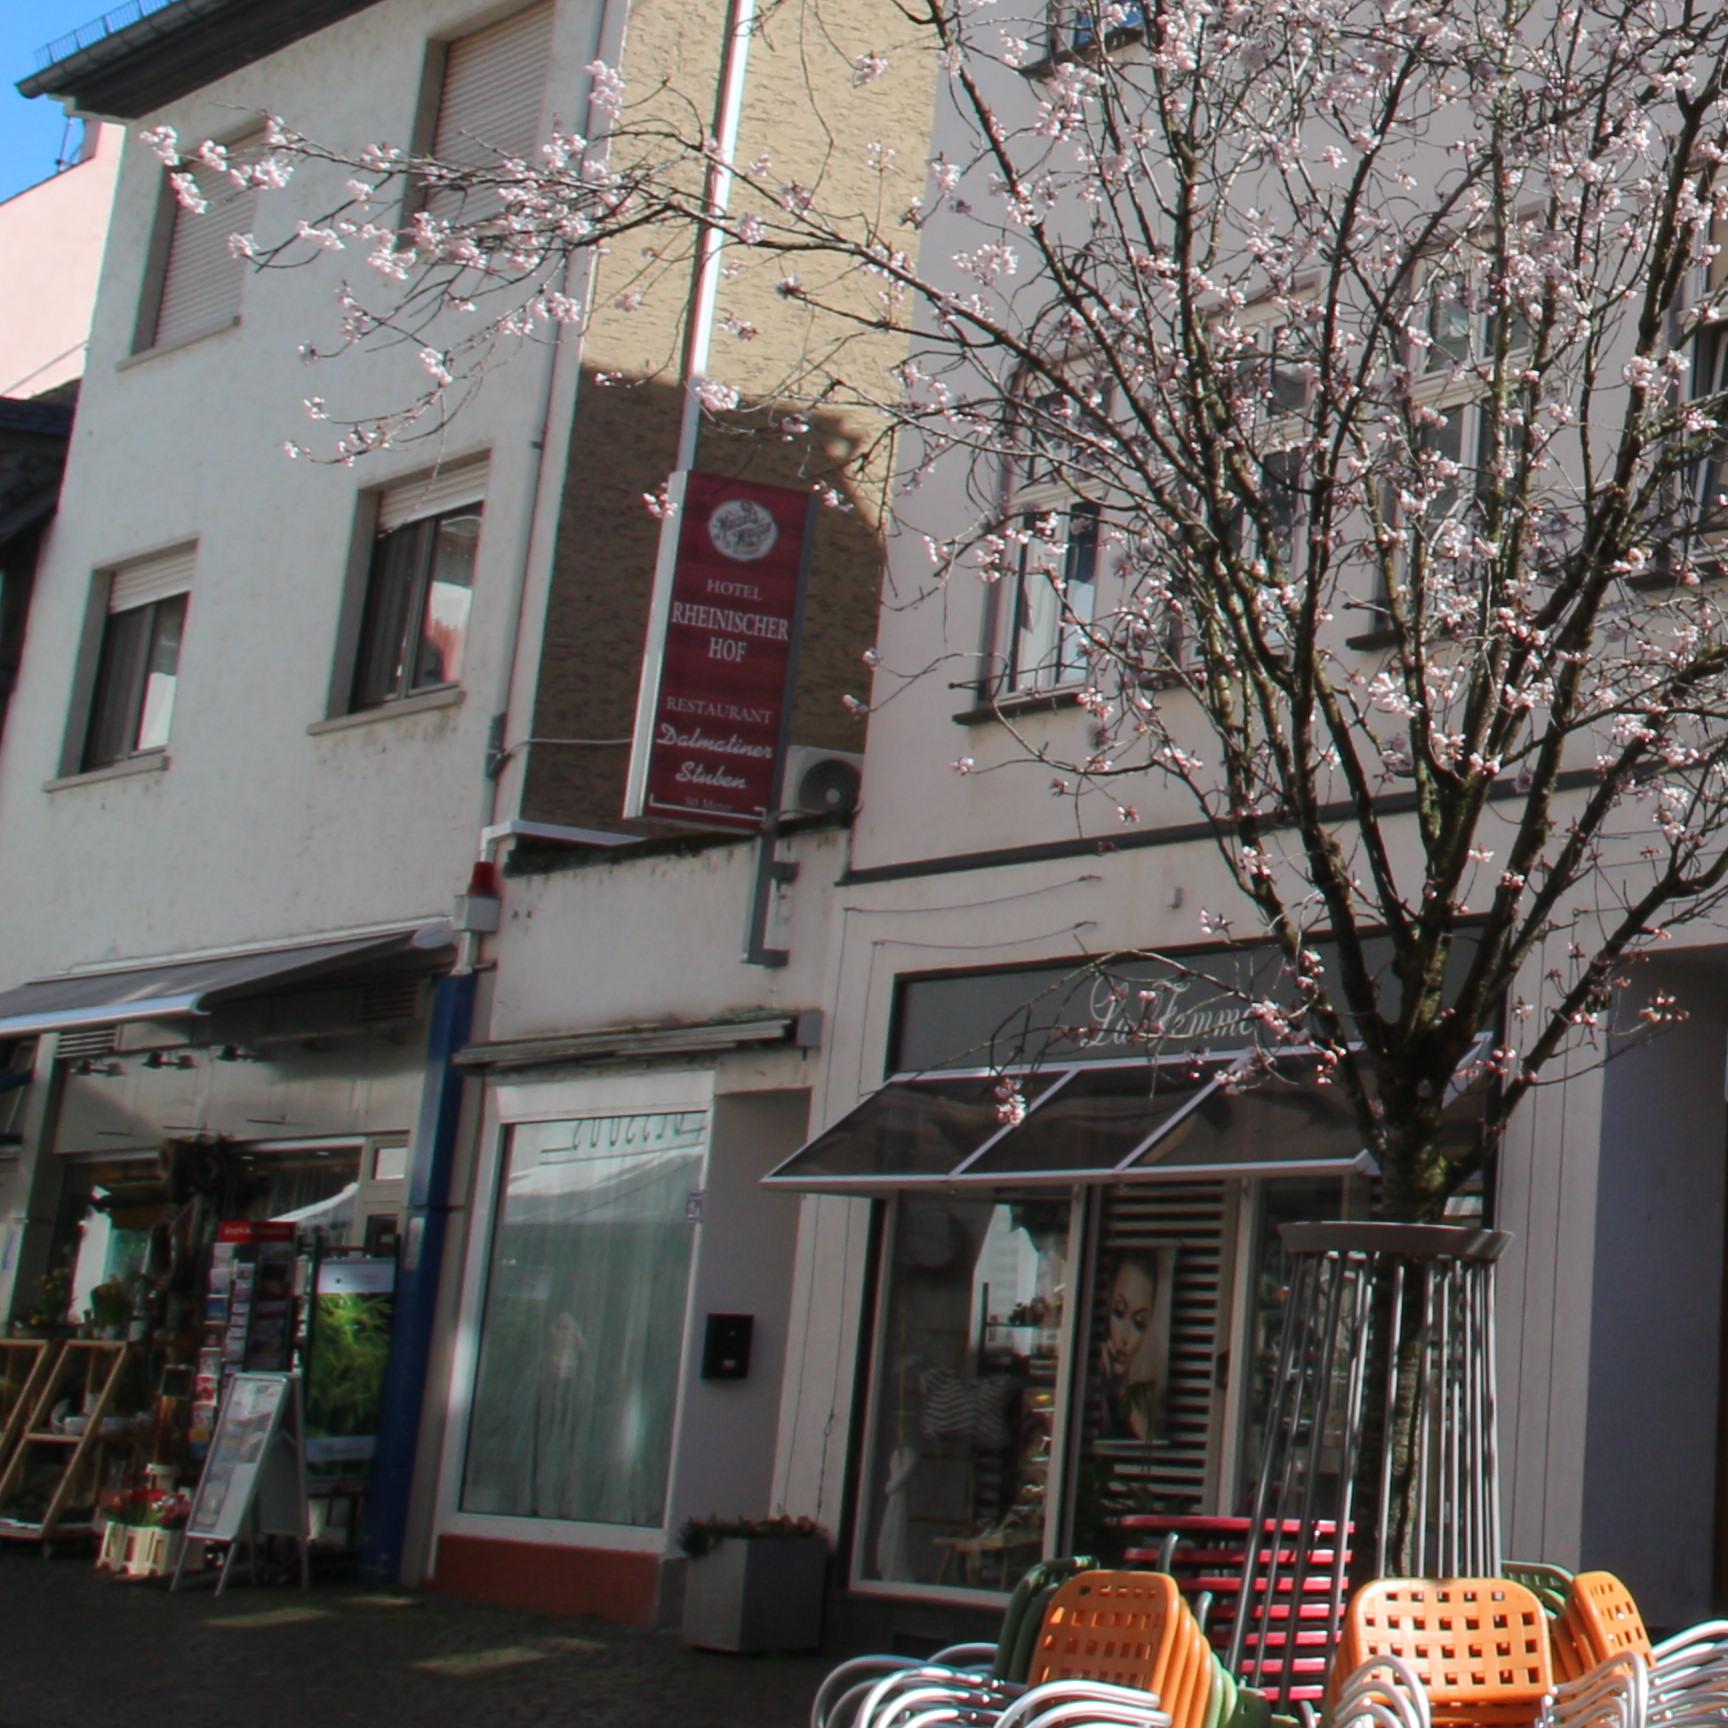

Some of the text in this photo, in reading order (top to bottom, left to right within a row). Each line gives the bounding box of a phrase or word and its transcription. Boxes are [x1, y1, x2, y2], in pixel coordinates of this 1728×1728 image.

[707, 578, 763, 602] HOTEL
[671, 601, 789, 641] RHEINISCHER
[708, 636, 747, 663] HOF
[666, 696, 774, 724] RESTAURANT
[656, 723, 774, 760] Dalmatiner
[675, 760, 748, 790] Stuben
